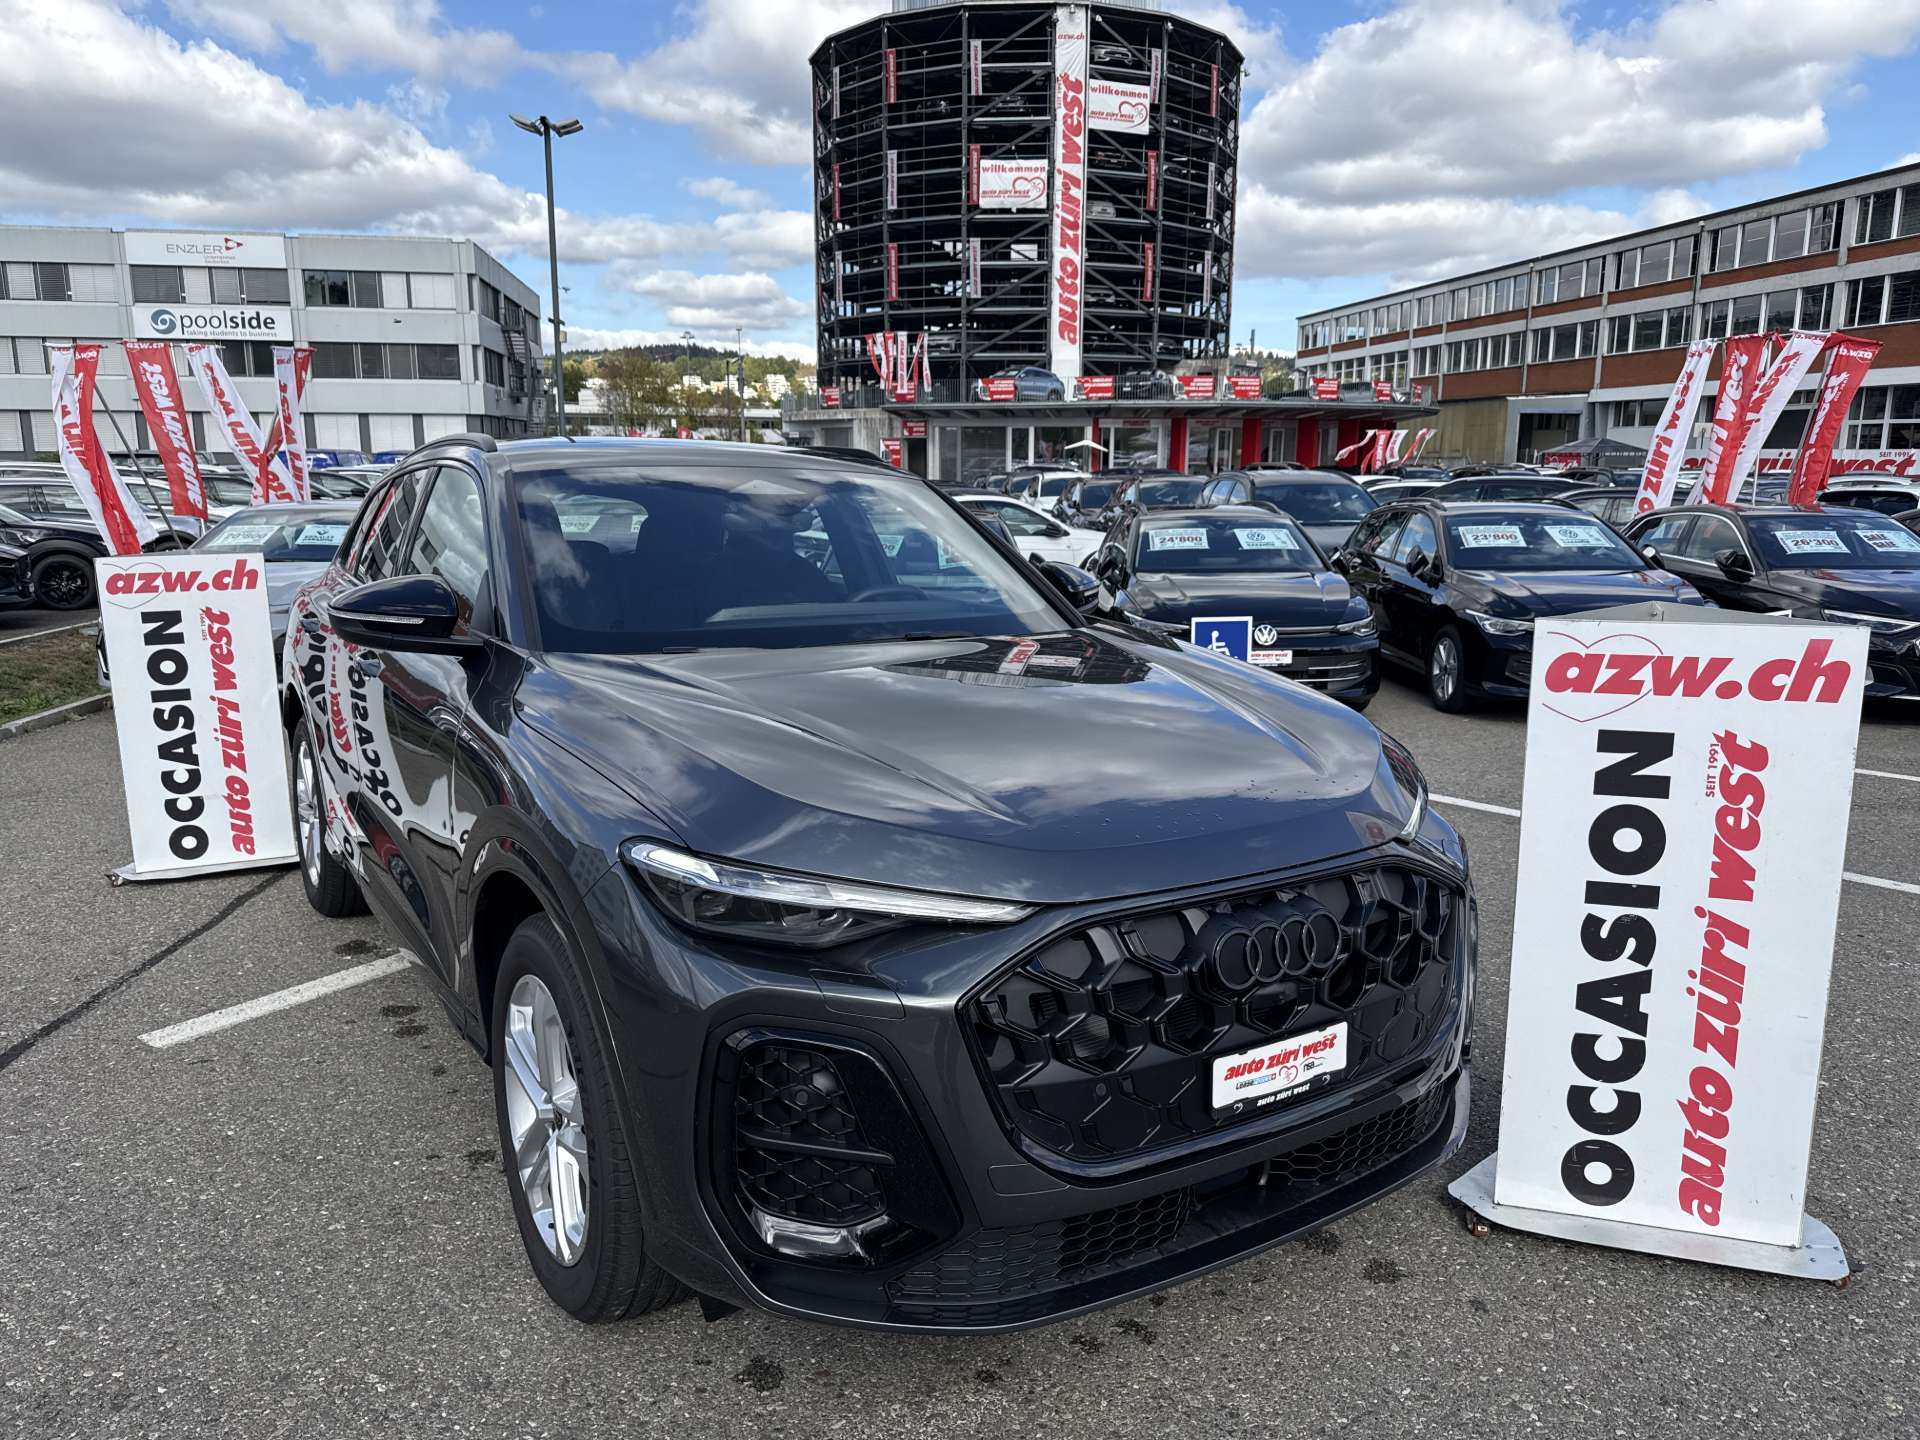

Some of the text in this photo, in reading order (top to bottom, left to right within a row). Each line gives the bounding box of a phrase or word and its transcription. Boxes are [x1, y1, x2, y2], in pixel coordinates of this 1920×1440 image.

[1090, 84, 1148, 99] willkommen
[981, 164, 1046, 173] willkommen
[1055, 71, 1084, 345] auto züri west
[166, 243, 223, 254] ENZLER
[180, 310, 276, 335] poolside
[186, 329, 208, 338] taking
[210, 329, 239, 337] students
[138, 360, 174, 410] west
[175, 450, 203, 511] auto
[1642, 434, 1674, 497] züri
[1471, 533, 1519, 541] 23'800
[1791, 539, 1839, 547] 26'300
[105, 559, 259, 596] azw.ch
[1544, 638, 1852, 705] azw.ch
[140, 609, 210, 861] OCCASION
[199, 606, 256, 856] auto züri west
[1705, 743, 1719, 799] SEIT 1991
[1560, 729, 1676, 1208] OCCASION
[1676, 728, 1771, 1228] auto züri west
[1224, 1032, 1338, 1081] auto züri west
[1256, 1083, 1311, 1107] auto züri west
